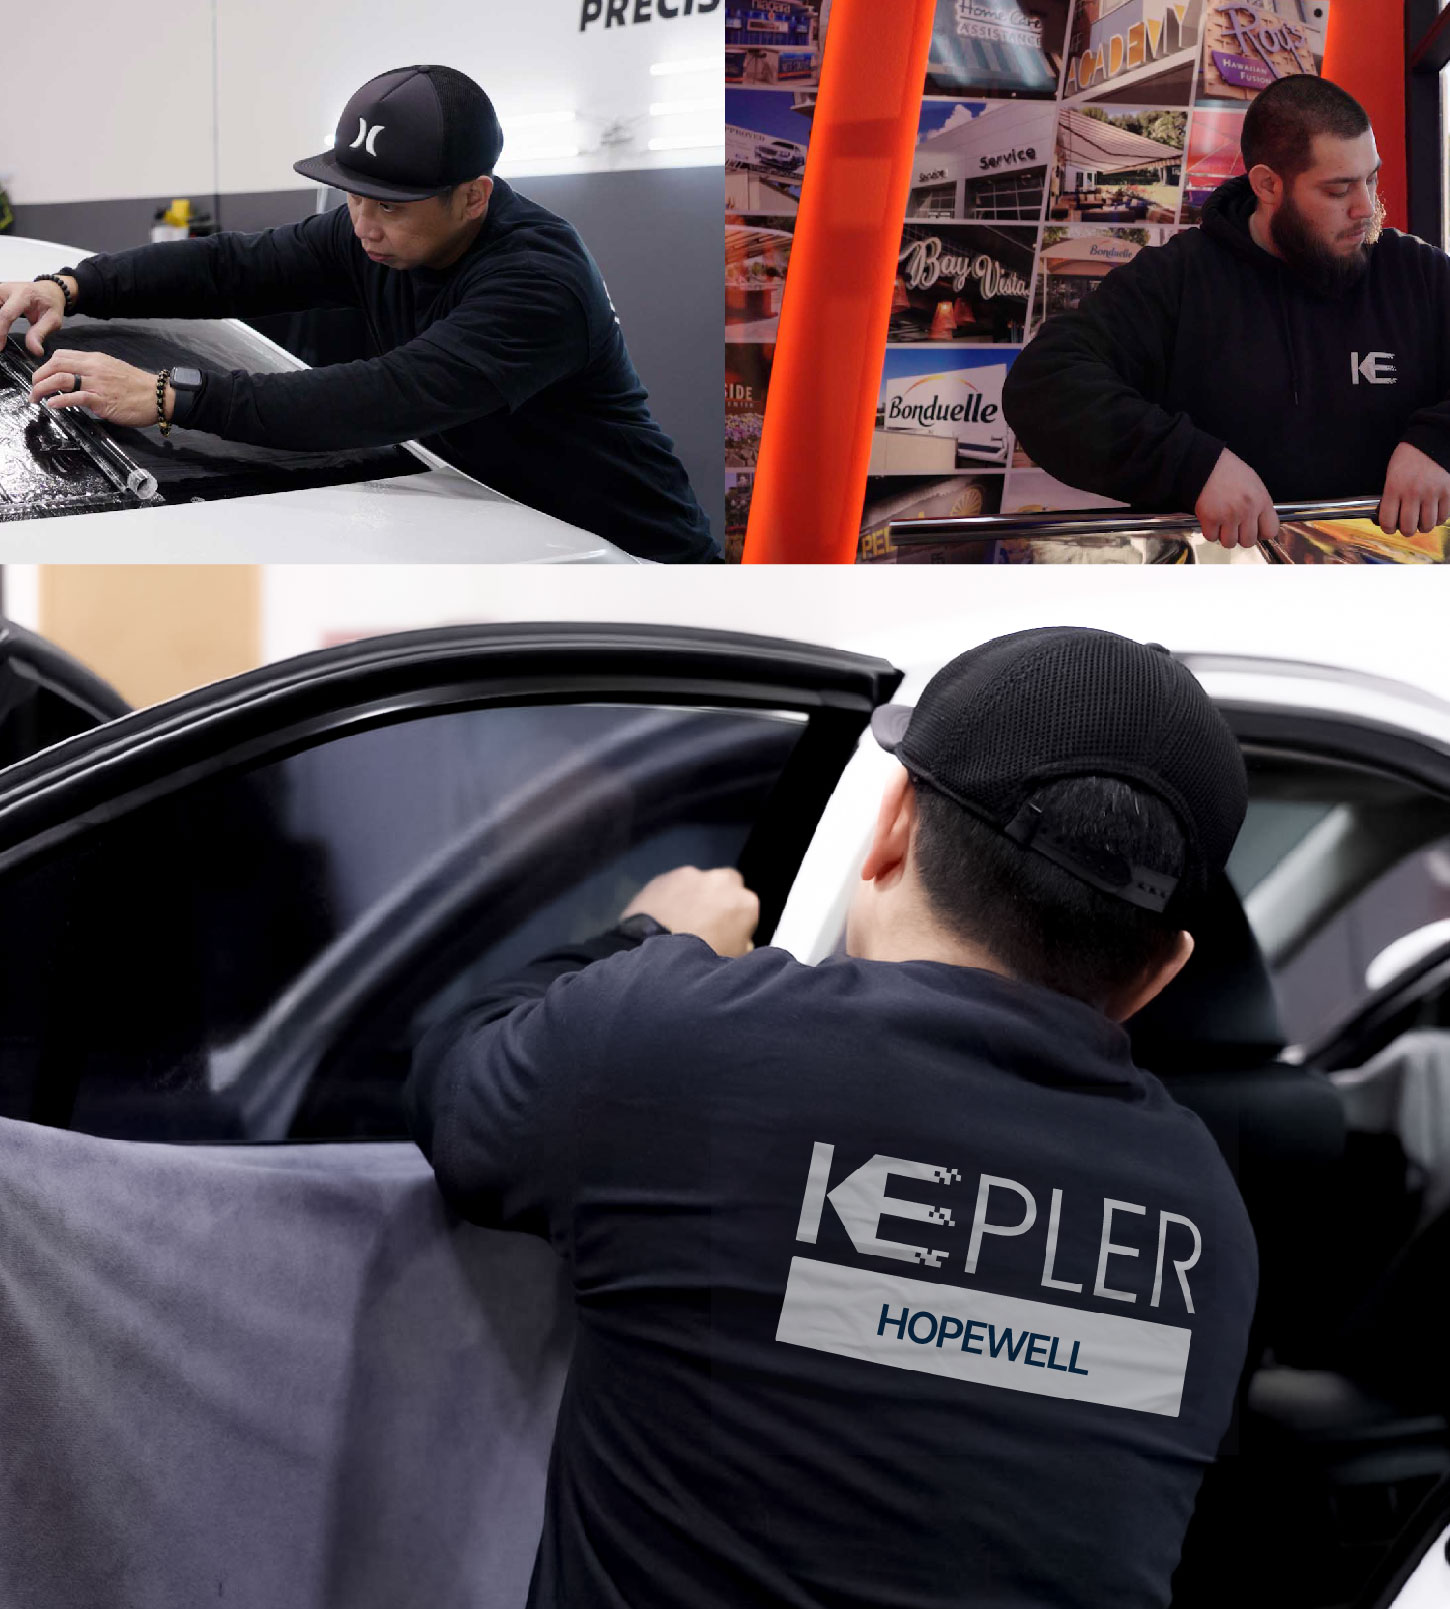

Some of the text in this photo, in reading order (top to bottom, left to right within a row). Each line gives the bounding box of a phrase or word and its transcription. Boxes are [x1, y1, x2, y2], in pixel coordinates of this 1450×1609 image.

[960, 23, 1041, 46] ASSISTANCE
[1064, 0, 1190, 97] ACADEMY
[980, 148, 1038, 170] Service
[899, 236, 1031, 300] Bay Vista
[888, 393, 998, 427] Bonduelle
[795, 1141, 1202, 1314] KEPLER
[876, 1303, 1089, 1376] HOPEWELL
